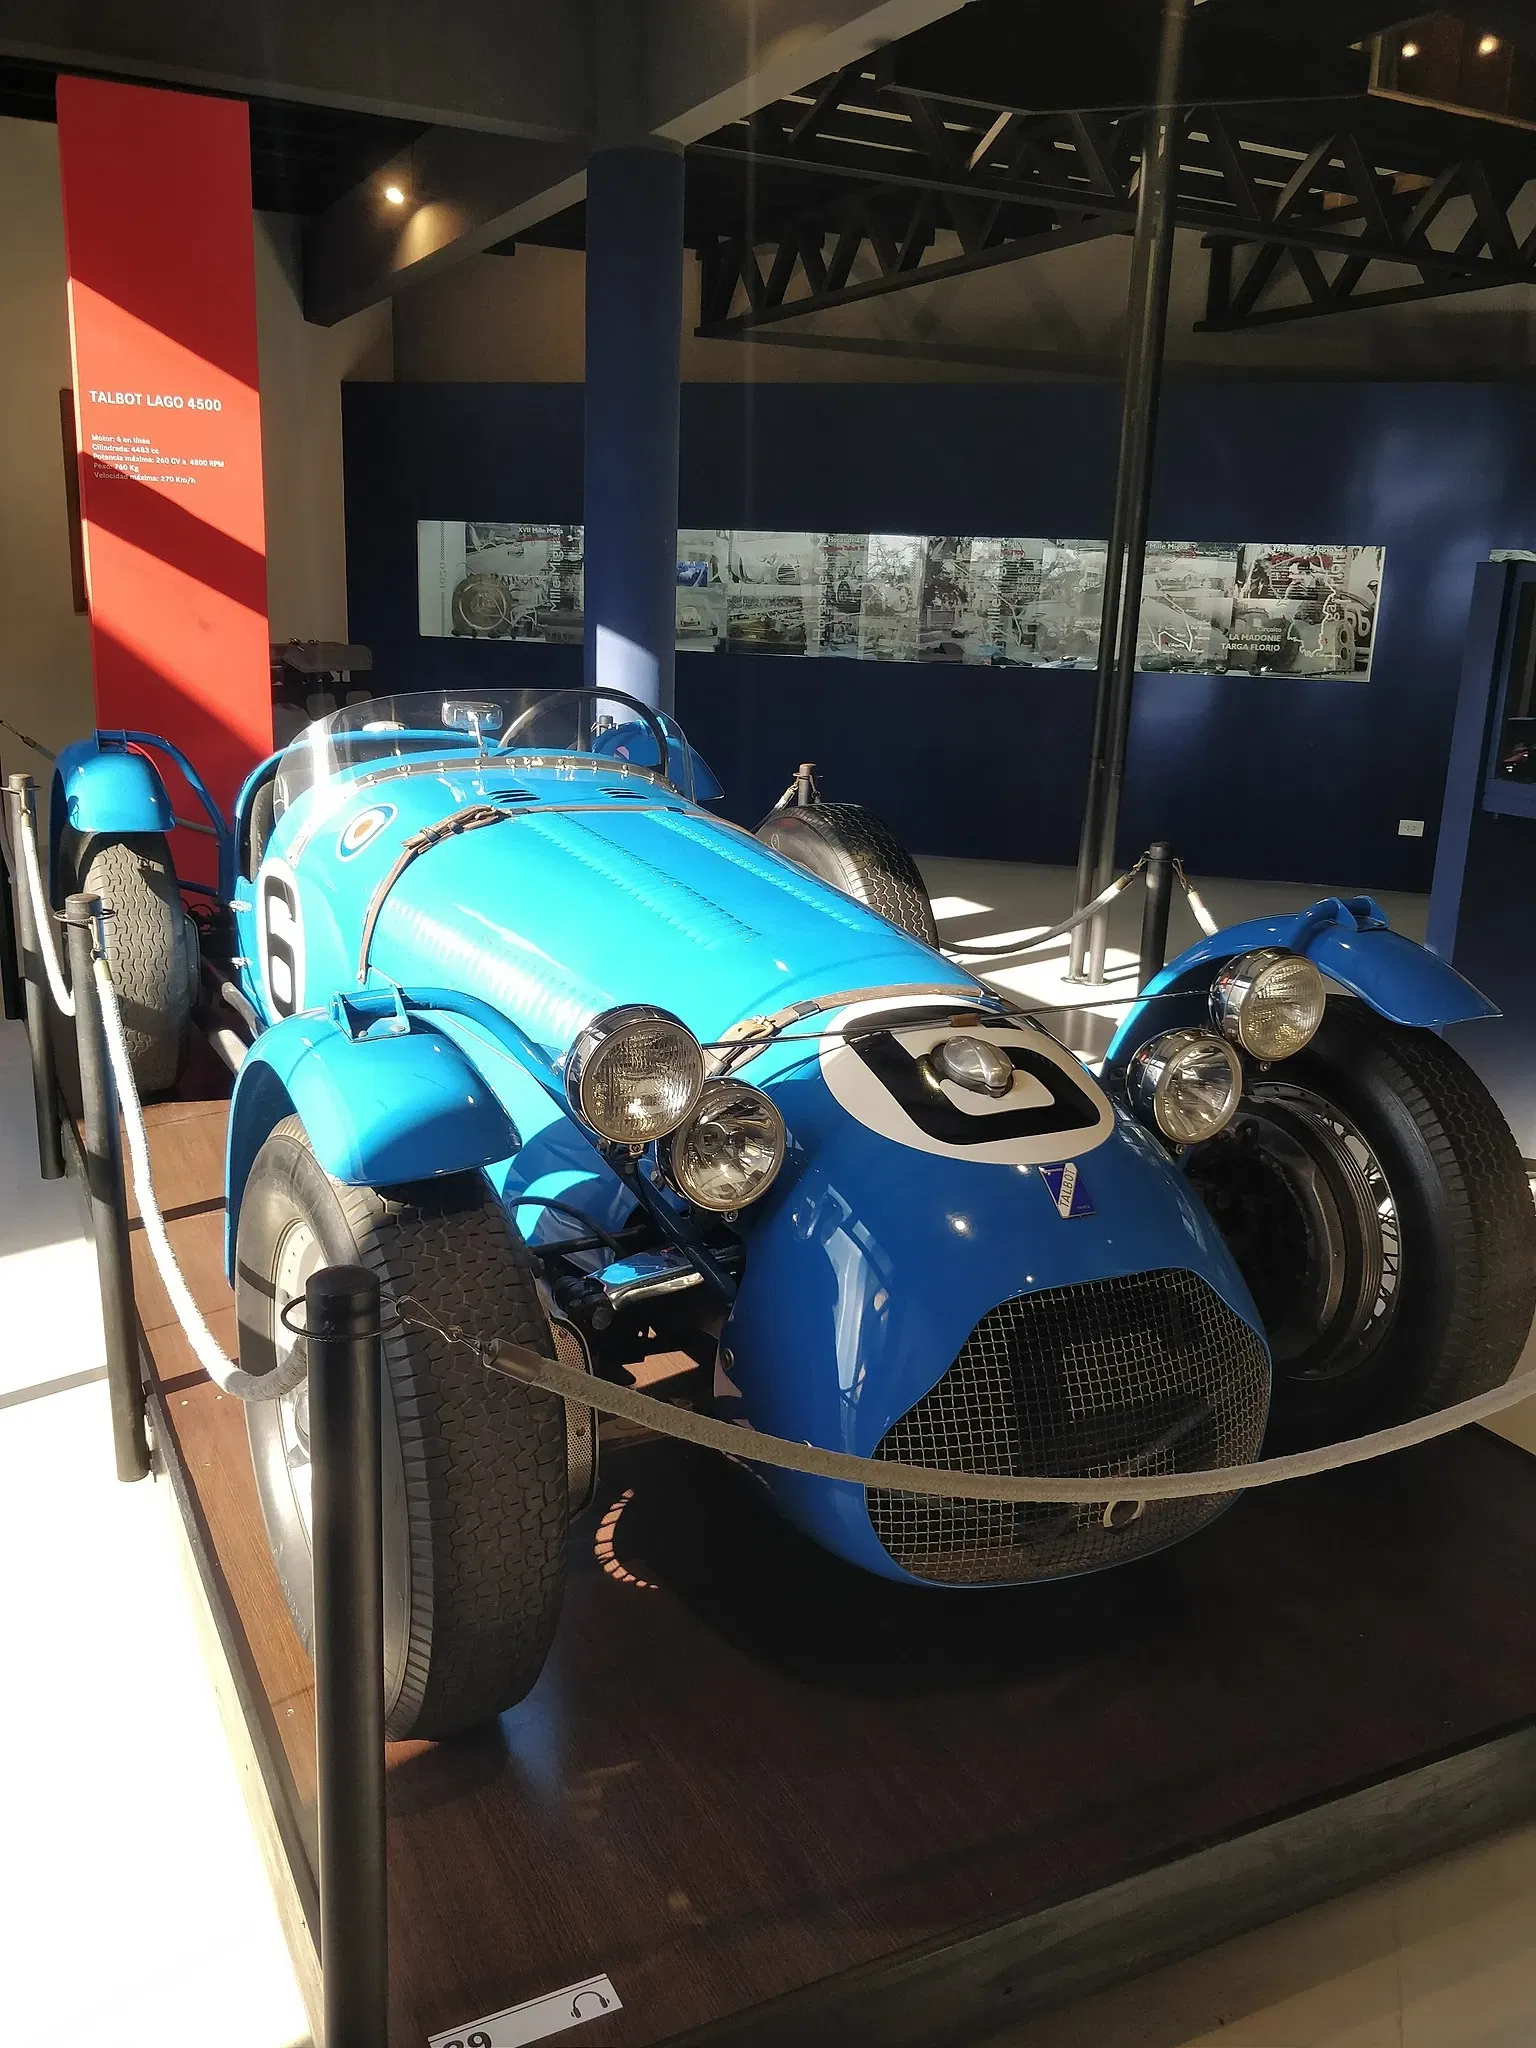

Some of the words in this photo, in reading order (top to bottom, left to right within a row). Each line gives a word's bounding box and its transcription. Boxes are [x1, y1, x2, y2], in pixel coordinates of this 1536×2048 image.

[88, 390, 142, 405] TALBOT
[146, 394, 184, 409] LAGO
[187, 398, 222, 412] 4500
[91, 434, 115, 442] Motor:
[92, 443, 130, 452] Cilindrada:
[93, 452, 124, 461] Potencia
[156, 456, 170, 464] 260
[170, 457, 180, 465] CV
[189, 458, 208, 466] 4800
[208, 459, 225, 468] RPM
[93, 462, 113, 470] Peso:
[129, 464, 139, 473] Kg
[93, 471, 129, 480] Velocidad
[160, 475, 175, 483] 270
[175, 476, 196, 485] Km/h
[549, 580, 561, 612] Mille
[1228, 633, 1240, 641] LA
[1241, 634, 1282, 642] MADONIE
[1220, 642, 1249, 650] TARGA
[1250, 643, 1281, 652] FLORIO
[263, 875, 297, 1019] 6
[1059, 1167, 1077, 1208] TALBOT
